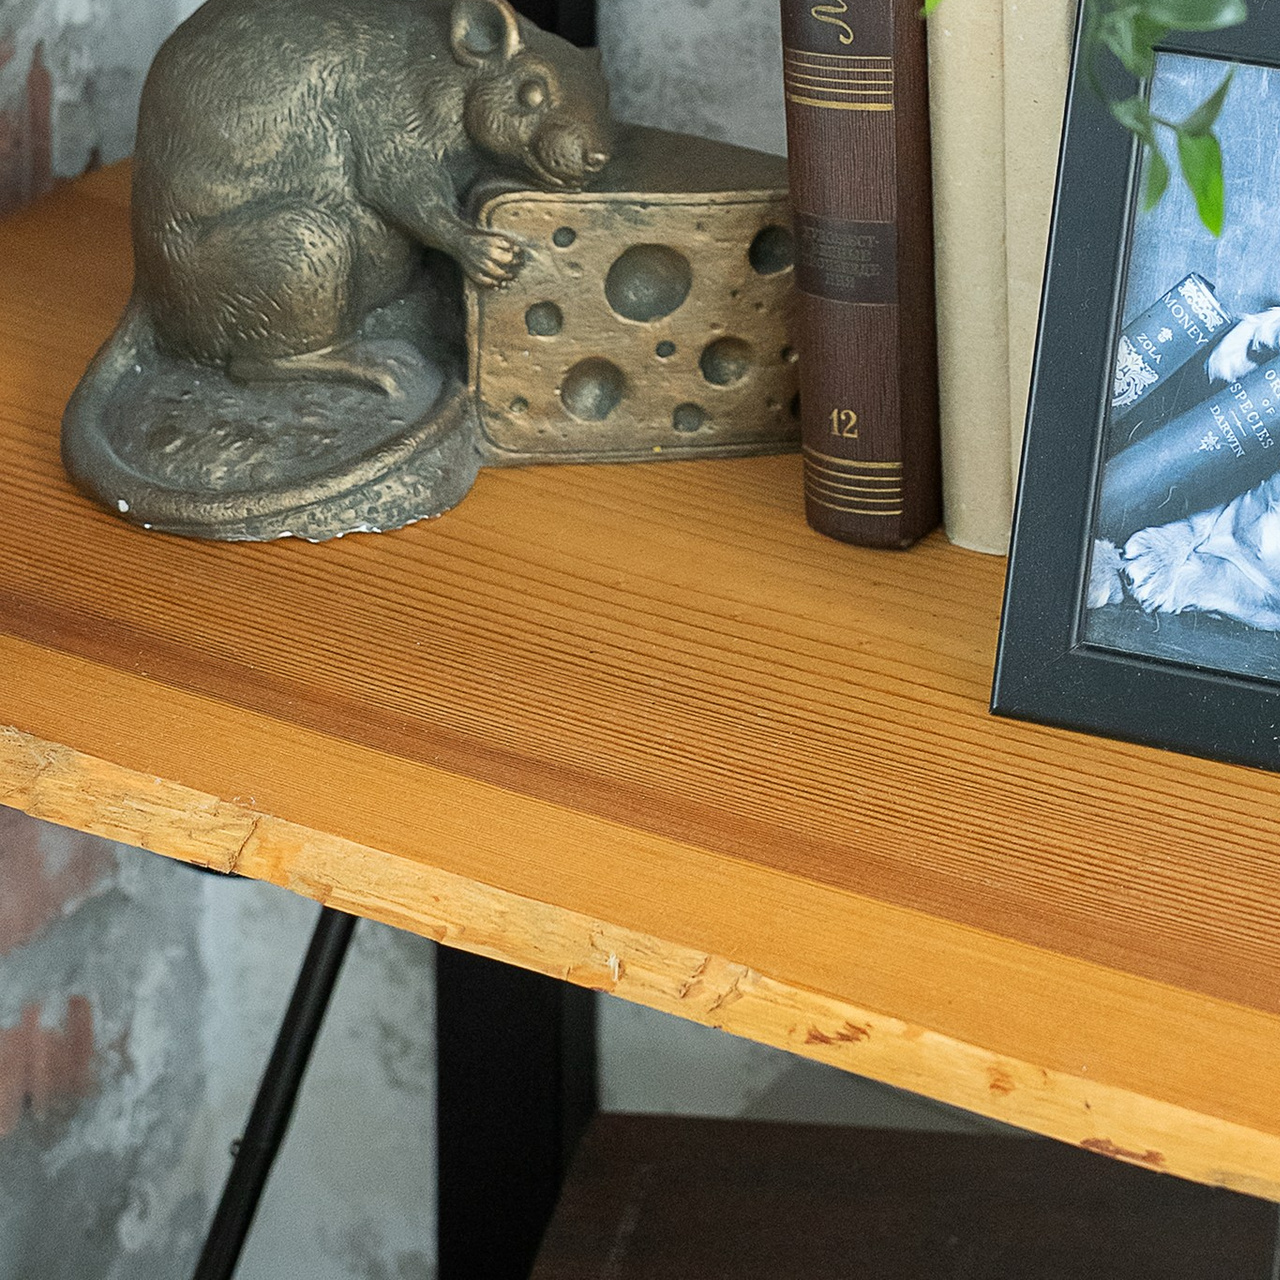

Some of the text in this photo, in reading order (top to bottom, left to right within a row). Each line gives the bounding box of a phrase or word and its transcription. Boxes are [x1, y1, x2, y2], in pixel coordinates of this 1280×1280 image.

[1162, 292, 1209, 347] MONEY
[1136, 333, 1163, 365] ZOLA
[828, 408, 859, 440] 12
[1230, 381, 1274, 449] SPECIES
[1261, 398, 1276, 415] OF
[1209, 404, 1247, 459] DARWIN
